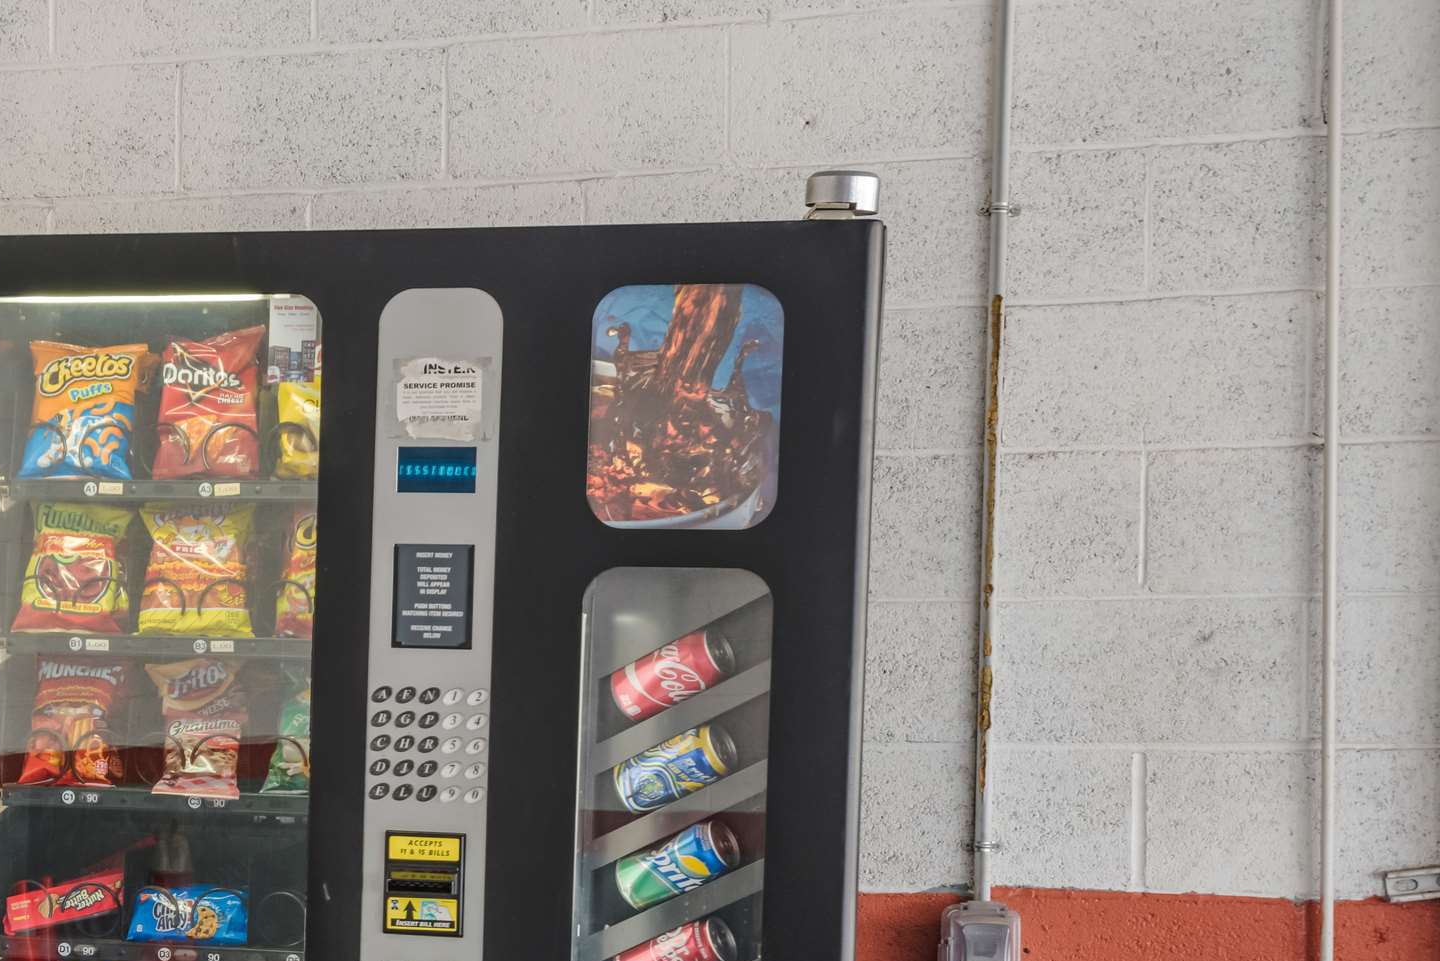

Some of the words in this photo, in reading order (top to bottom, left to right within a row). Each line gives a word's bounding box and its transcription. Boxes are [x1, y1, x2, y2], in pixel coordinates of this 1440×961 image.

[41, 353, 131, 395] Cheetos
[162, 362, 242, 387] Doritos
[440, 381, 476, 389] PROMISE
[69, 384, 112, 401] Puffs
[85, 484, 96, 493] A1
[70, 639, 81, 648] B1
[195, 641, 205, 650] B3
[378, 690, 387, 699] A
[402, 690, 412, 699] F
[425, 690, 436, 700] N
[452, 691, 458, 701] 1
[475, 692, 483, 702] 2
[378, 713, 387, 723] B
[400, 714, 410, 724] G
[425, 715, 435, 724] P
[450, 715, 457, 725] 3
[474, 716, 482, 726] 4
[376, 738, 386, 748] C
[400, 738, 410, 748] H
[424, 739, 434, 749] R
[449, 740, 457, 750] 5
[473, 741, 480, 751] 6
[375, 762, 385, 771] D
[400, 763, 409, 773] J
[424, 763, 433, 773] T
[449, 764, 456, 774] 7
[472, 765, 480, 775] 8
[63, 792, 74, 801] C1
[375, 786, 385, 796] E
[400, 787, 408, 797] L
[423, 788, 432, 798] U
[449, 788, 456, 798] 9
[472, 790, 479, 800] 0
[408, 839, 443, 848] ACCEPTS
[428, 849, 450, 857] BILLS
[76, 889, 105, 911] Nutter
[395, 919, 419, 927] INSERT
[60, 945, 71, 955] D1
[82, 946, 95, 956] 90
[160, 950, 170, 959] D3
[207, 953, 220, 961] 90
